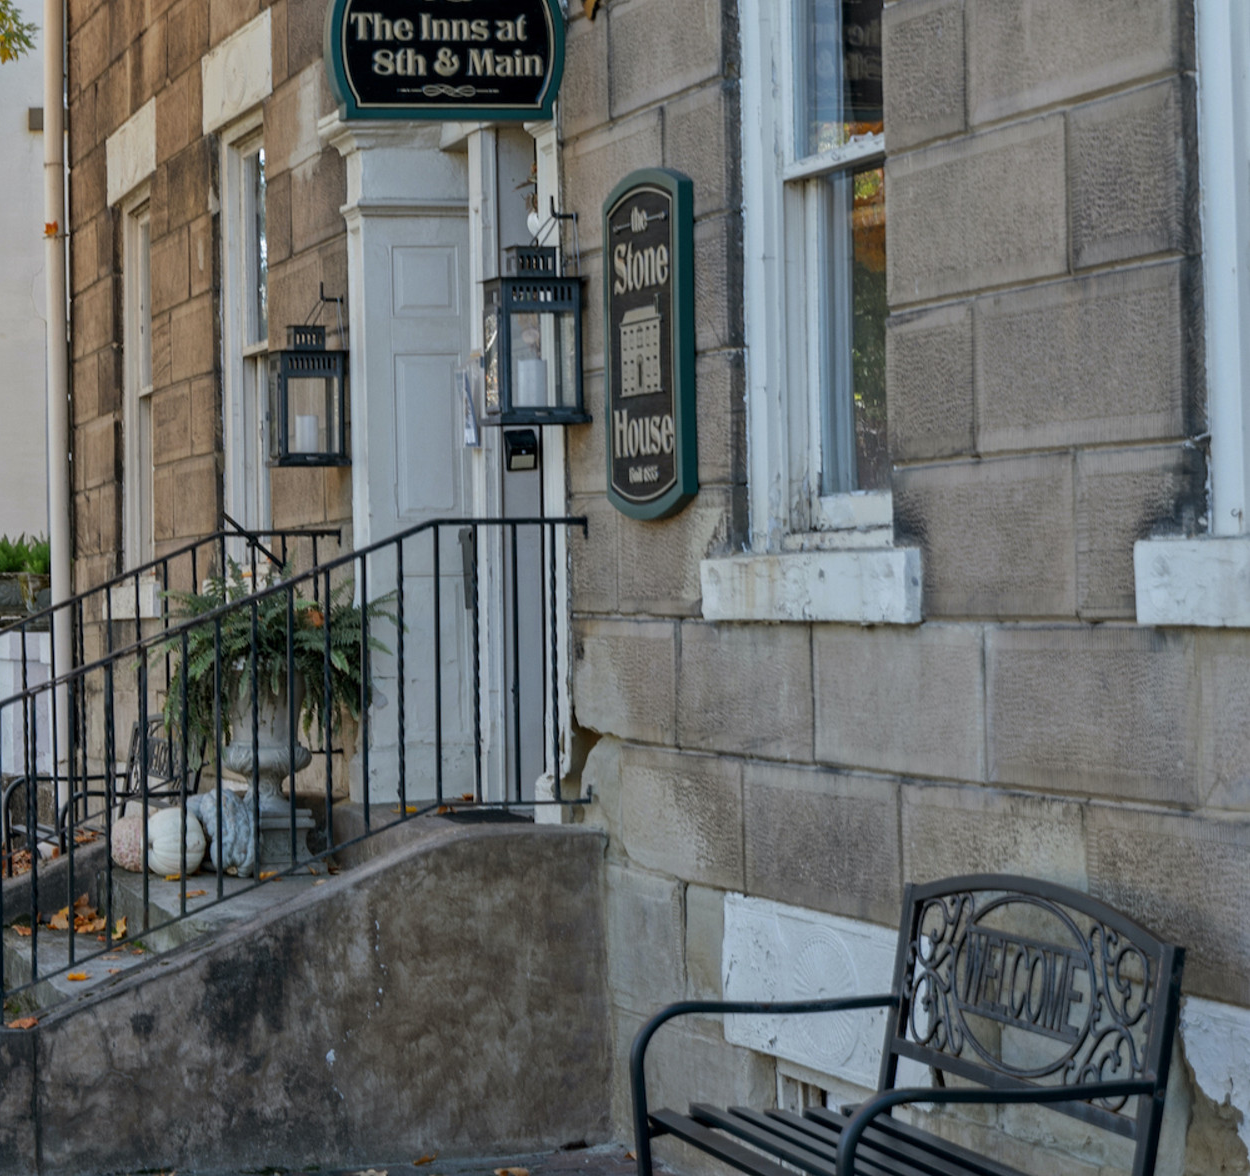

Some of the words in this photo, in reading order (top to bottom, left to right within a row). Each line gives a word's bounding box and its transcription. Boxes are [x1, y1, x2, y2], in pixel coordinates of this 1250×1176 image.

[350, 12, 414, 42] The
[419, 12, 488, 42] Inns
[495, 13, 528, 42] at
[372, 48, 427, 76] 8th
[433, 46, 460, 77] &
[467, 48, 544, 77] Main
[631, 206, 648, 232] the
[613, 241, 669, 296] Stone
[613, 409, 674, 459] House
[960, 929, 1088, 1038] WELCOME
